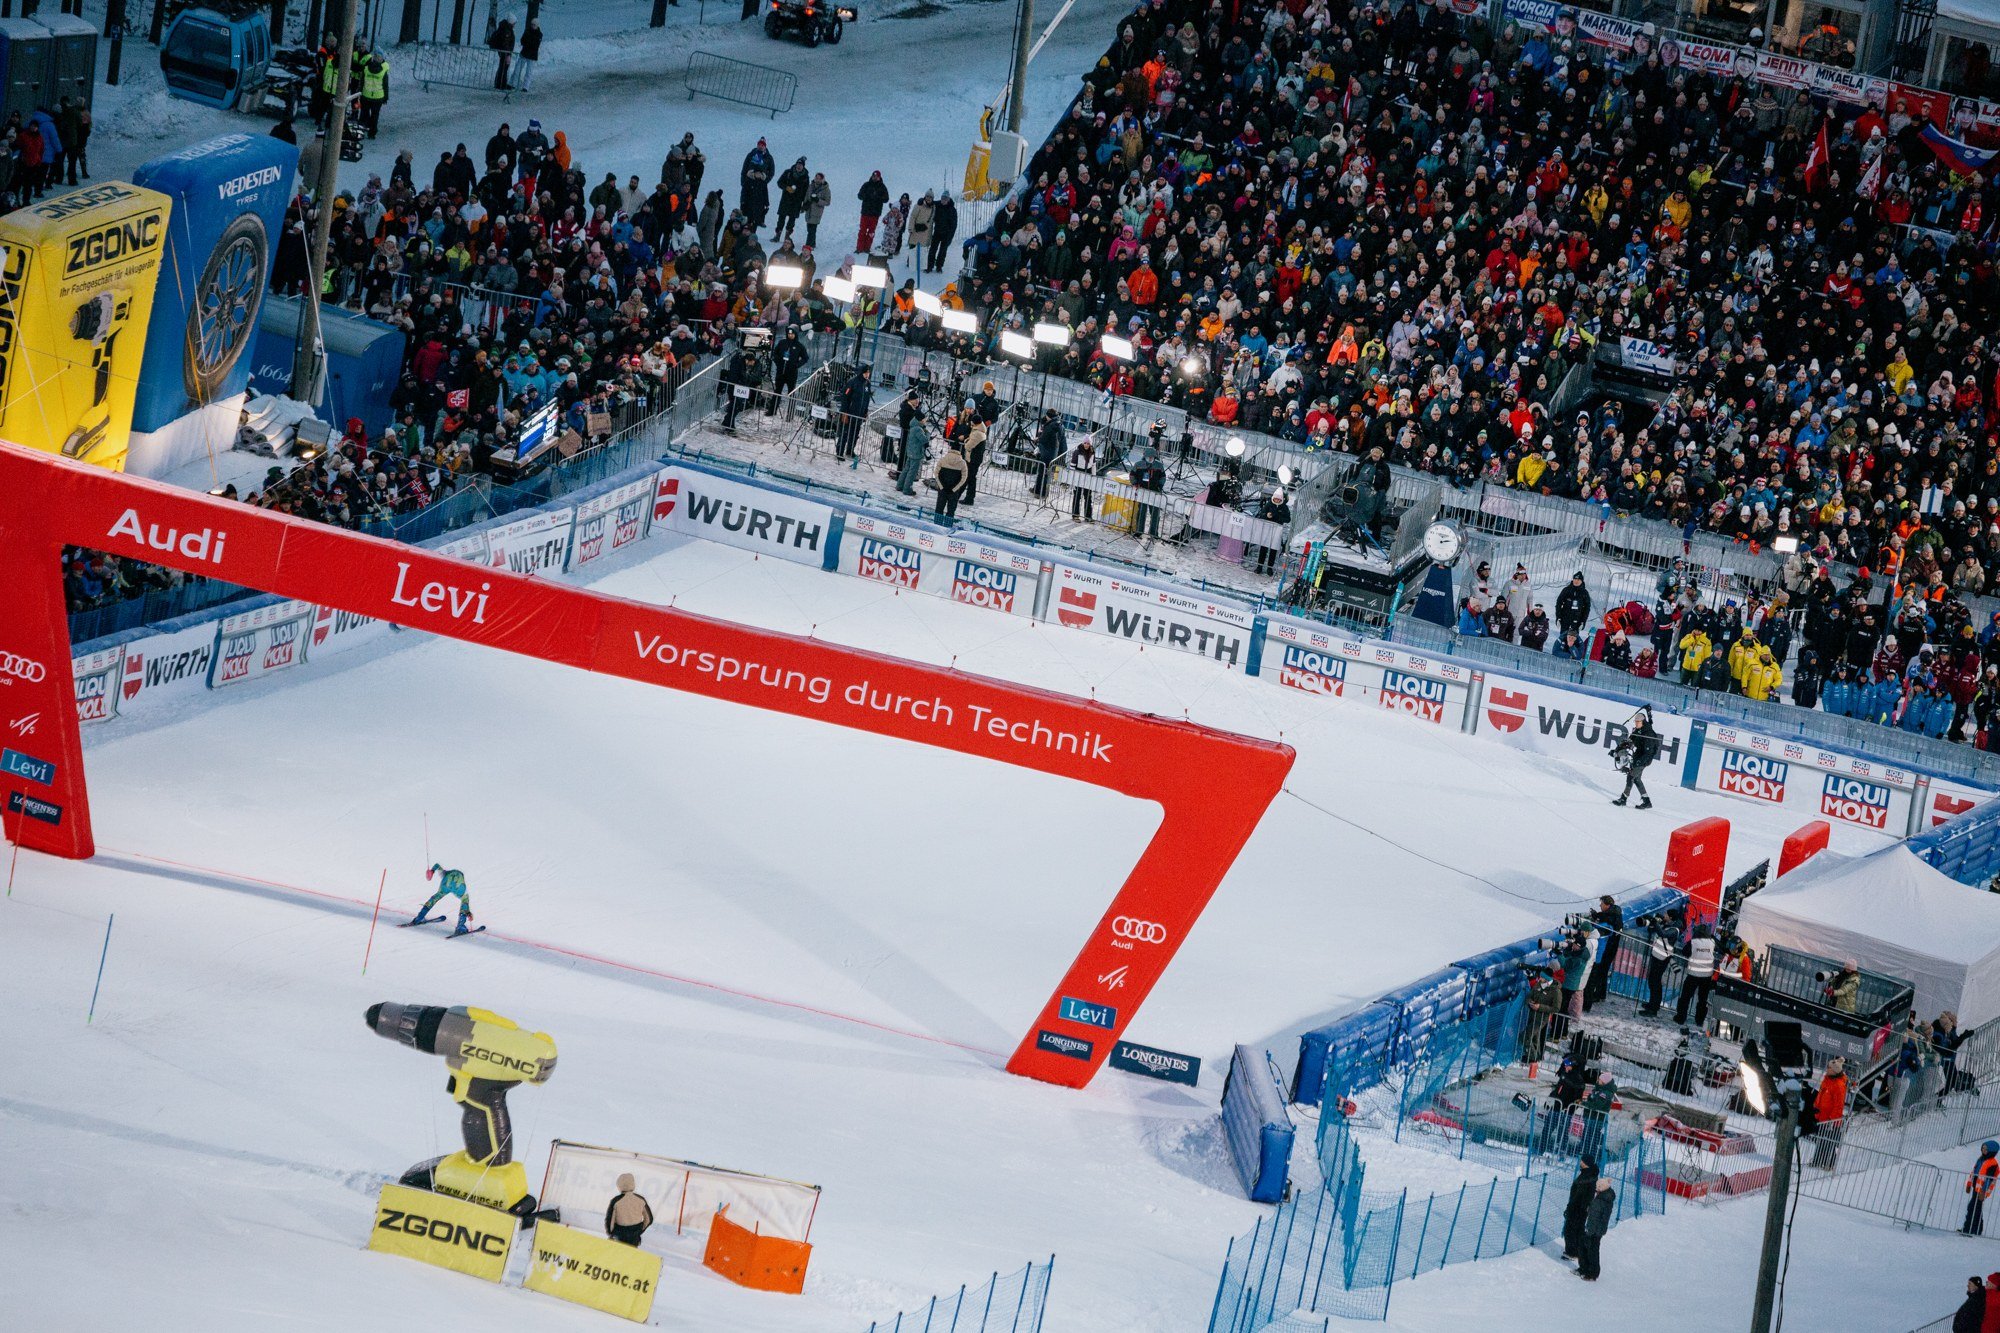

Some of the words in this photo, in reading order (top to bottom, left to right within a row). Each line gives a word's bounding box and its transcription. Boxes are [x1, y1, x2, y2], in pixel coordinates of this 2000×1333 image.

[1507, 0, 1554, 18] GIORGIA
[1582, 14, 1633, 37] MARTINA
[1684, 44, 1731, 63] LEONA
[1815, 67, 1864, 90] MIKAELA
[218, 164, 282, 200] VREDESTEIN
[236, 193, 258, 207] TYRES
[67, 214, 160, 273] ZGONC
[60, 286, 71, 297] Ihr
[1627, 340, 1662, 355] AAD
[736, 388, 747, 396] RAI
[687, 490, 821, 551] WÜRTH
[858, 517, 874, 527] LIQUI
[857, 523, 874, 532] MOLY
[889, 525, 905, 534] LIQUI
[107, 508, 226, 564] Audi
[888, 531, 905, 540] MOLY
[920, 533, 934, 542] LIQUI
[919, 538, 933, 547] MOLY
[949, 541, 966, 549] LIQUI
[863, 539, 920, 568] LIQUI
[948, 546, 965, 554] MOLY
[981, 548, 997, 557] LIQUI
[980, 553, 997, 562] MOLY
[1012, 556, 1029, 565] LIQUI
[1011, 561, 1028, 570] MOLY
[861, 559, 919, 588] MOLY
[956, 561, 1015, 592] LIQUI
[1073, 573, 1102, 586] WÜRTH
[391, 561, 491, 624] Levi
[953, 581, 1013, 612] MOLY
[1121, 585, 1150, 598] WÜRTH
[1169, 596, 1198, 610] WÜRTH
[1216, 608, 1244, 623] WÜRTH
[1105, 606, 1240, 665] WÜRTH
[1278, 631, 1296, 640] MOLY
[1279, 625, 1297, 634] LIQUI
[1311, 639, 1328, 648] MOLY
[1312, 633, 1329, 643] LIQUI
[1343, 642, 1361, 651] LIQUI
[1343, 647, 1360, 656] MOLY
[263, 643, 293, 669] MOLY
[1375, 654, 1394, 663] MOLY
[1376, 649, 1394, 659] LIQUI
[1286, 647, 1344, 678] LIQUI
[1408, 662, 1426, 671] MOLY
[1409, 656, 1427, 666] LIQUI
[1441, 670, 1458, 679] MOLY
[1442, 664, 1459, 673] LIQUI
[0, 677, 13, 686] udi
[1282, 667, 1343, 696] MOLY
[1385, 671, 1444, 701] LIQUI
[633, 630, 832, 703] Vorsprung
[844, 681, 954, 726] durch
[968, 704, 1114, 763] Technik
[1382, 692, 1442, 721] MOLY
[1538, 705, 1680, 765] WÜRH
[1718, 734, 1736, 743] MOLY
[1719, 728, 1736, 737] LIQUI
[1751, 742, 1769, 751] MOLY
[1752, 736, 1770, 745] LIQUI
[1784, 750, 1802, 760] MOLY
[1785, 745, 1803, 754] LIQUI
[1818, 758, 1836, 768] MOLY
[1819, 753, 1836, 762] LIQUI
[9, 753, 47, 781] Levi
[1725, 751, 1786, 781] LIQUI
[1851, 766, 1869, 776] MOLY
[1852, 760, 1870, 770] LIQUI
[1885, 774, 1903, 784] MOLY
[1886, 769, 1904, 779] LIQUI
[1721, 771, 1784, 801] MOLY
[1826, 776, 1888, 807] LIQUI
[13, 795, 59, 817] LONGINES
[1823, 798, 1887, 828] MOLY
[1111, 939, 1134, 951] Audi
[1068, 1001, 1107, 1026] Levi
[1042, 1034, 1089, 1052] LONGINES
[462, 1044, 535, 1075] ZGONC
[1122, 1047, 1189, 1072] LONGINES
[378, 1207, 506, 1257] ZGONC
[538, 1249, 650, 1294] www.zgonc.at
